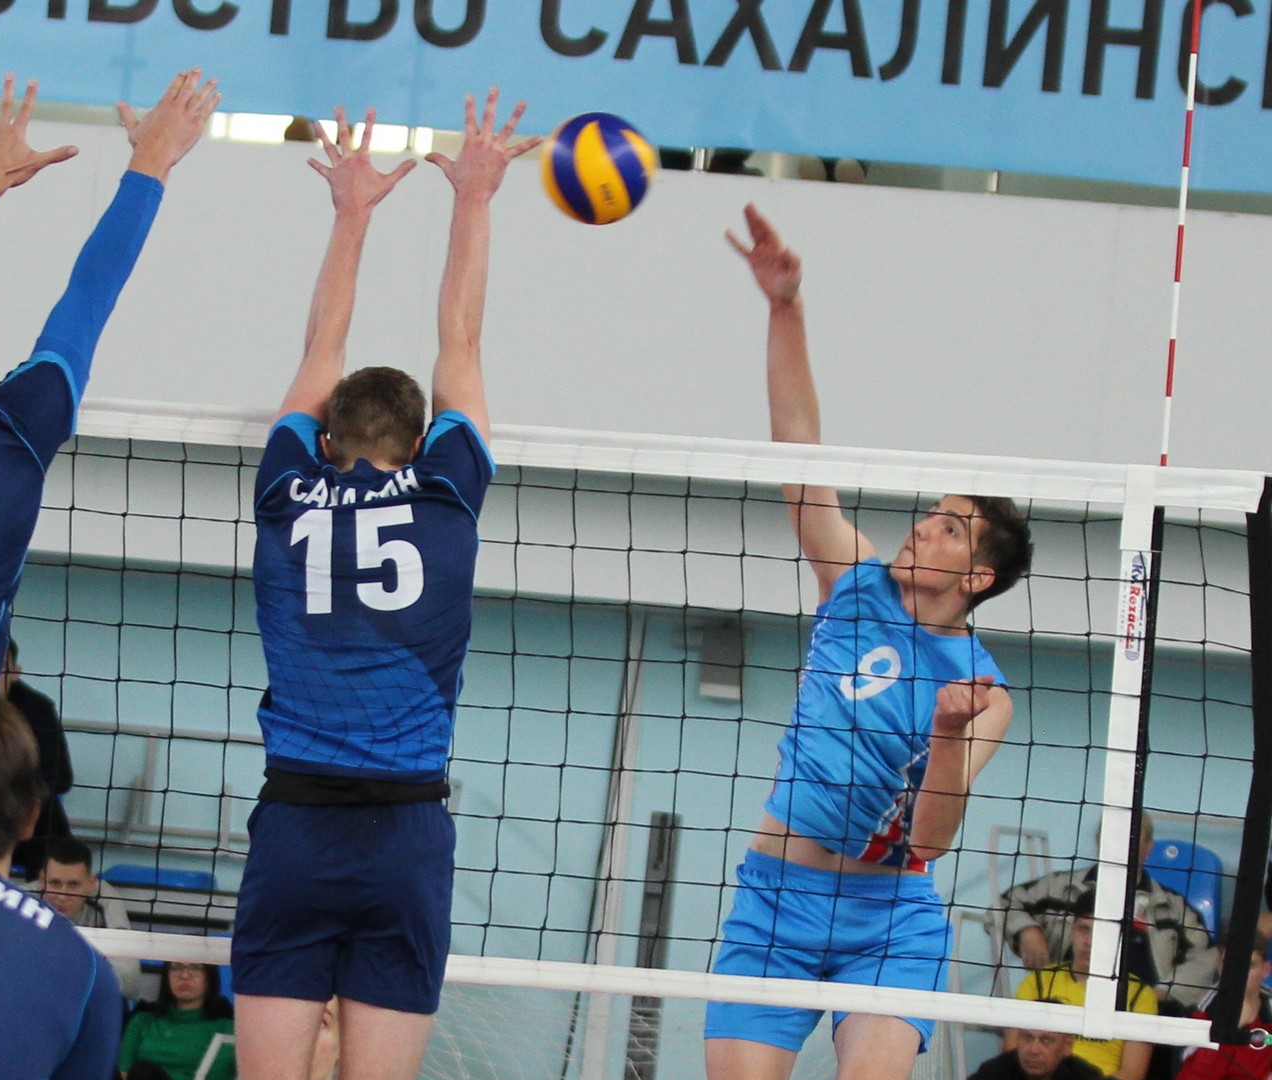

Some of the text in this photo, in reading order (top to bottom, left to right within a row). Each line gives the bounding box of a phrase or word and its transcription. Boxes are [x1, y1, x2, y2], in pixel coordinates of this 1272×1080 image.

[539, 0, 1272, 110] САХАЛИНС
[290, 504, 424, 615] 15
[840, 645, 902, 702] 9
